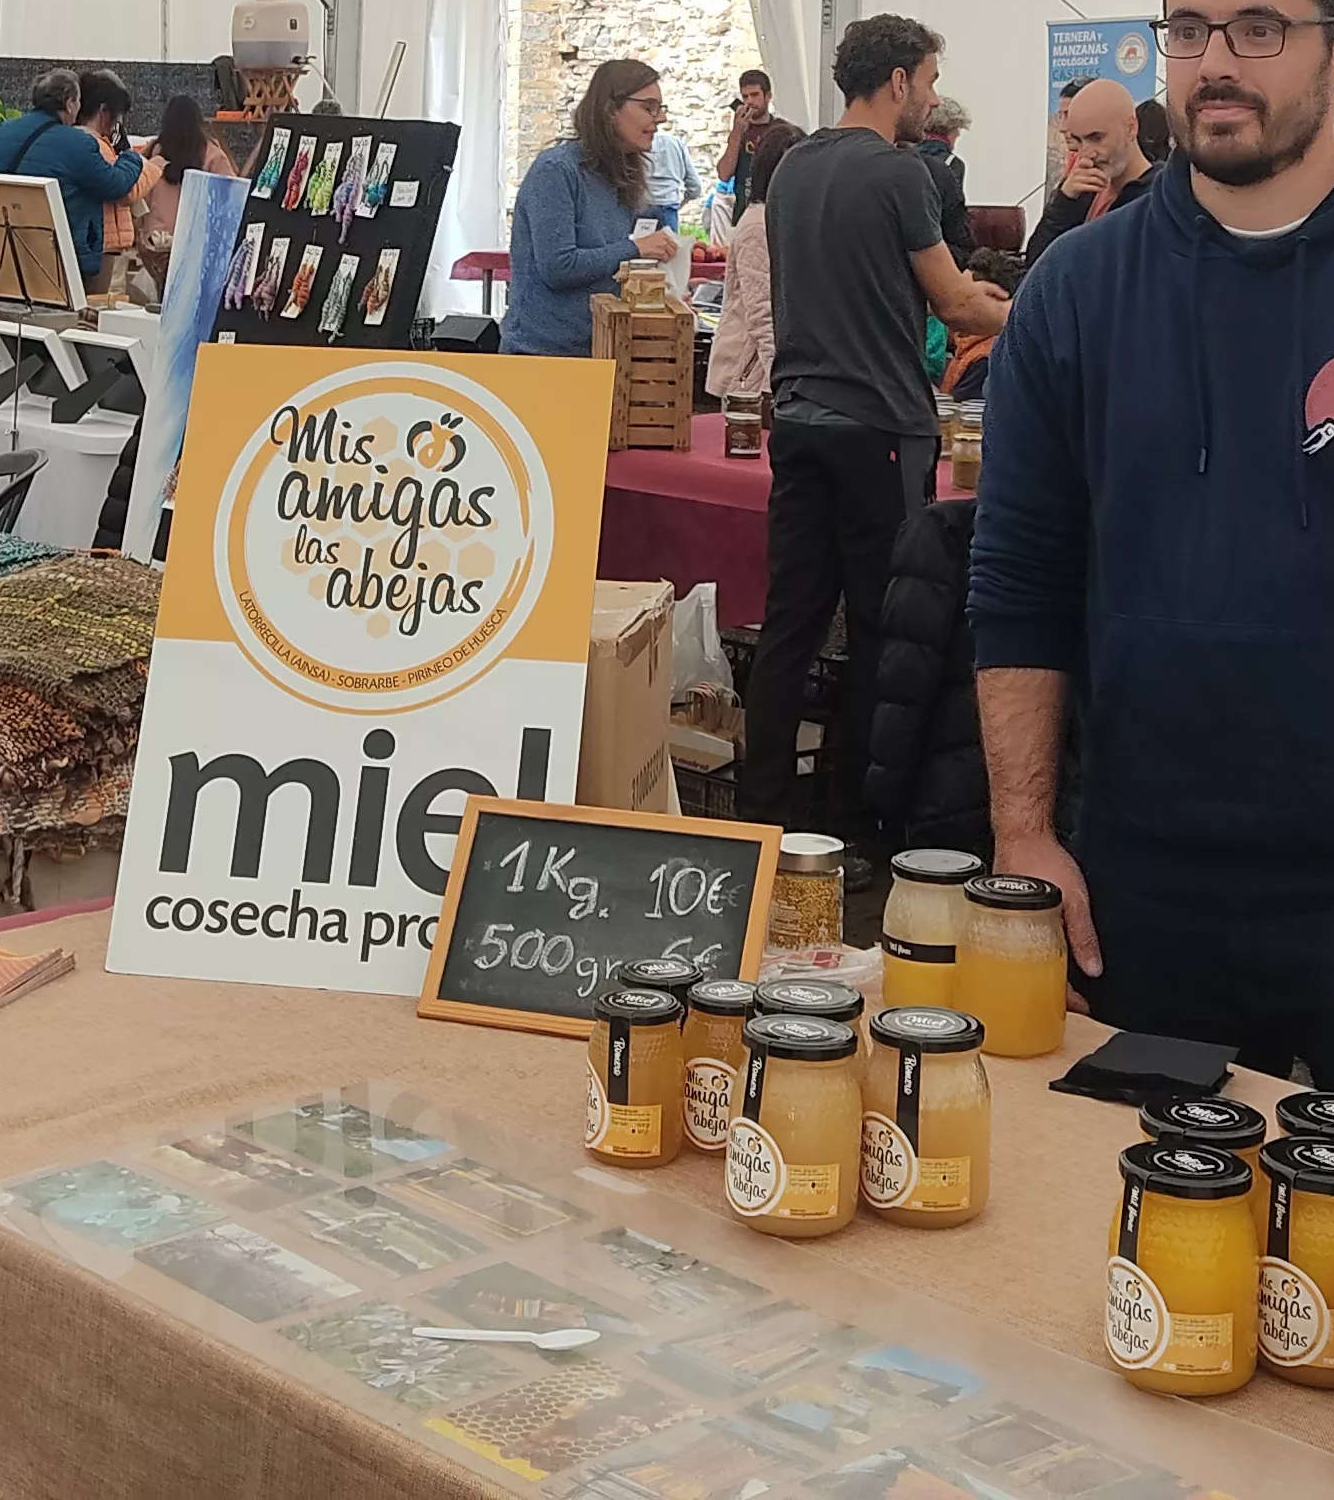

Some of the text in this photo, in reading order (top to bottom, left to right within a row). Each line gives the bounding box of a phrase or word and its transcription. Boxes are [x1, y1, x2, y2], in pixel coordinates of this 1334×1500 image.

[1053, 31, 1096, 44] TERNERA
[1053, 43, 1109, 57] MANZANAS
[269, 405, 376, 466] Mis
[277, 464, 496, 570] amigas
[294, 523, 342, 566] las
[326, 547, 484, 637] abejas
[239, 590, 508, 690] LATORRECILLA (AINSA) SOBRARBE PIRINEO DE HUESCA
[144, 888, 438, 963] cosecha pro
[620, 993, 660, 1005] Miel
[906, 1015, 947, 1028] Miel
[613, 1037, 626, 1077] Romero
[686, 1066, 704, 1087] Mis
[749, 1056, 763, 1099] Romero
[904, 1054, 917, 1096] Romero
[685, 1085, 729, 1118] amiga
[1187, 1105, 1230, 1122] Miel
[693, 1109, 729, 1136] abeja
[1175, 1153, 1216, 1171] Miel
[1127, 1205, 1138, 1233] flores
[1274, 1202, 1286, 1230] flores
[1112, 1320, 1150, 1354] abejas
[1263, 1317, 1308, 1351] abejas
